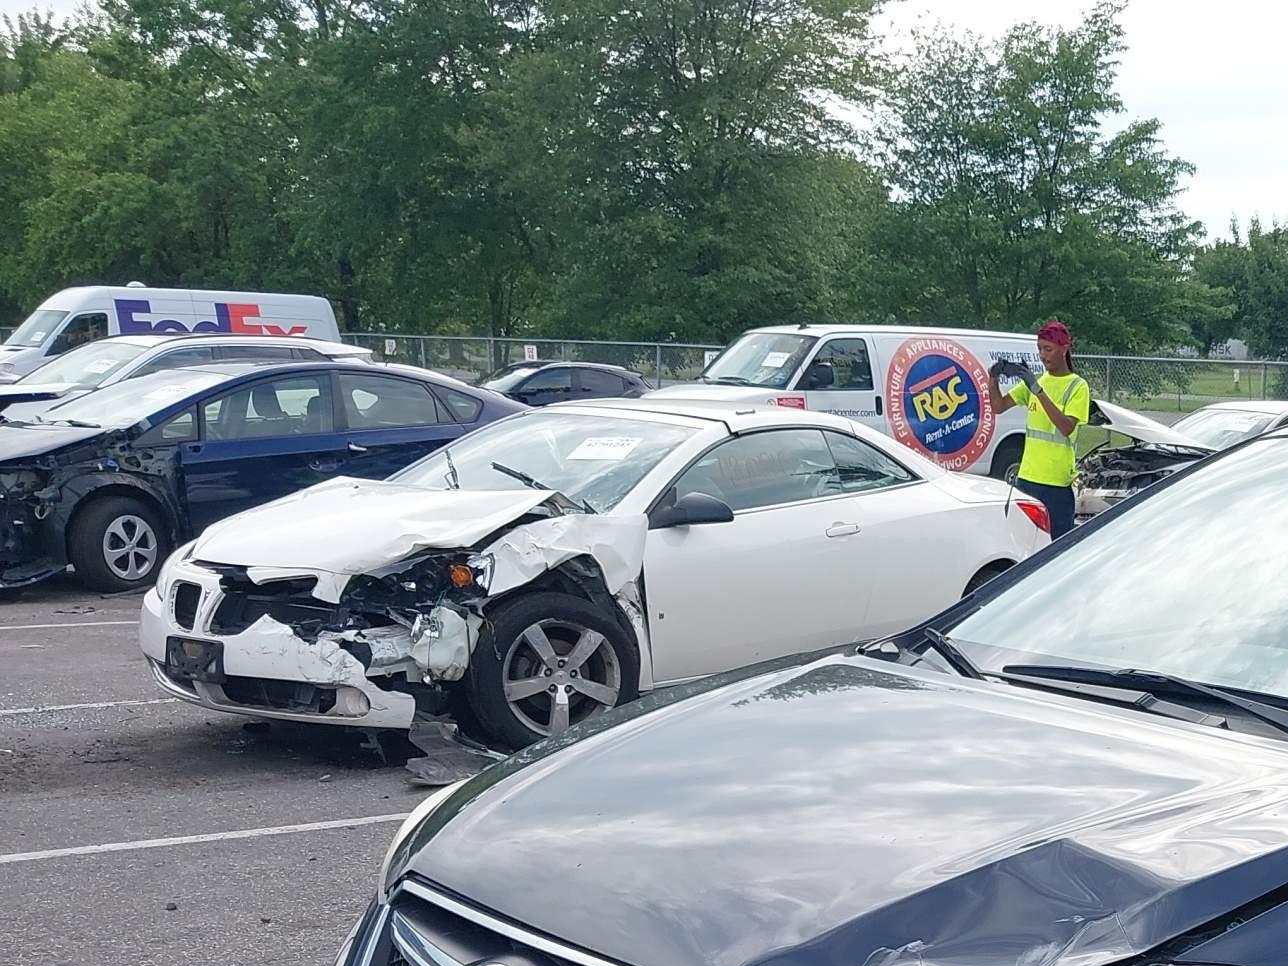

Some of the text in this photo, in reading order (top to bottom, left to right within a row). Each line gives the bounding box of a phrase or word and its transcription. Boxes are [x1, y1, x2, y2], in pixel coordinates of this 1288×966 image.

[905, 340, 964, 361] APPLIANCES
[891, 364, 908, 438] FURNITURE
[912, 375, 968, 423] RAC
[973, 368, 992, 449] ELECTRONICS
